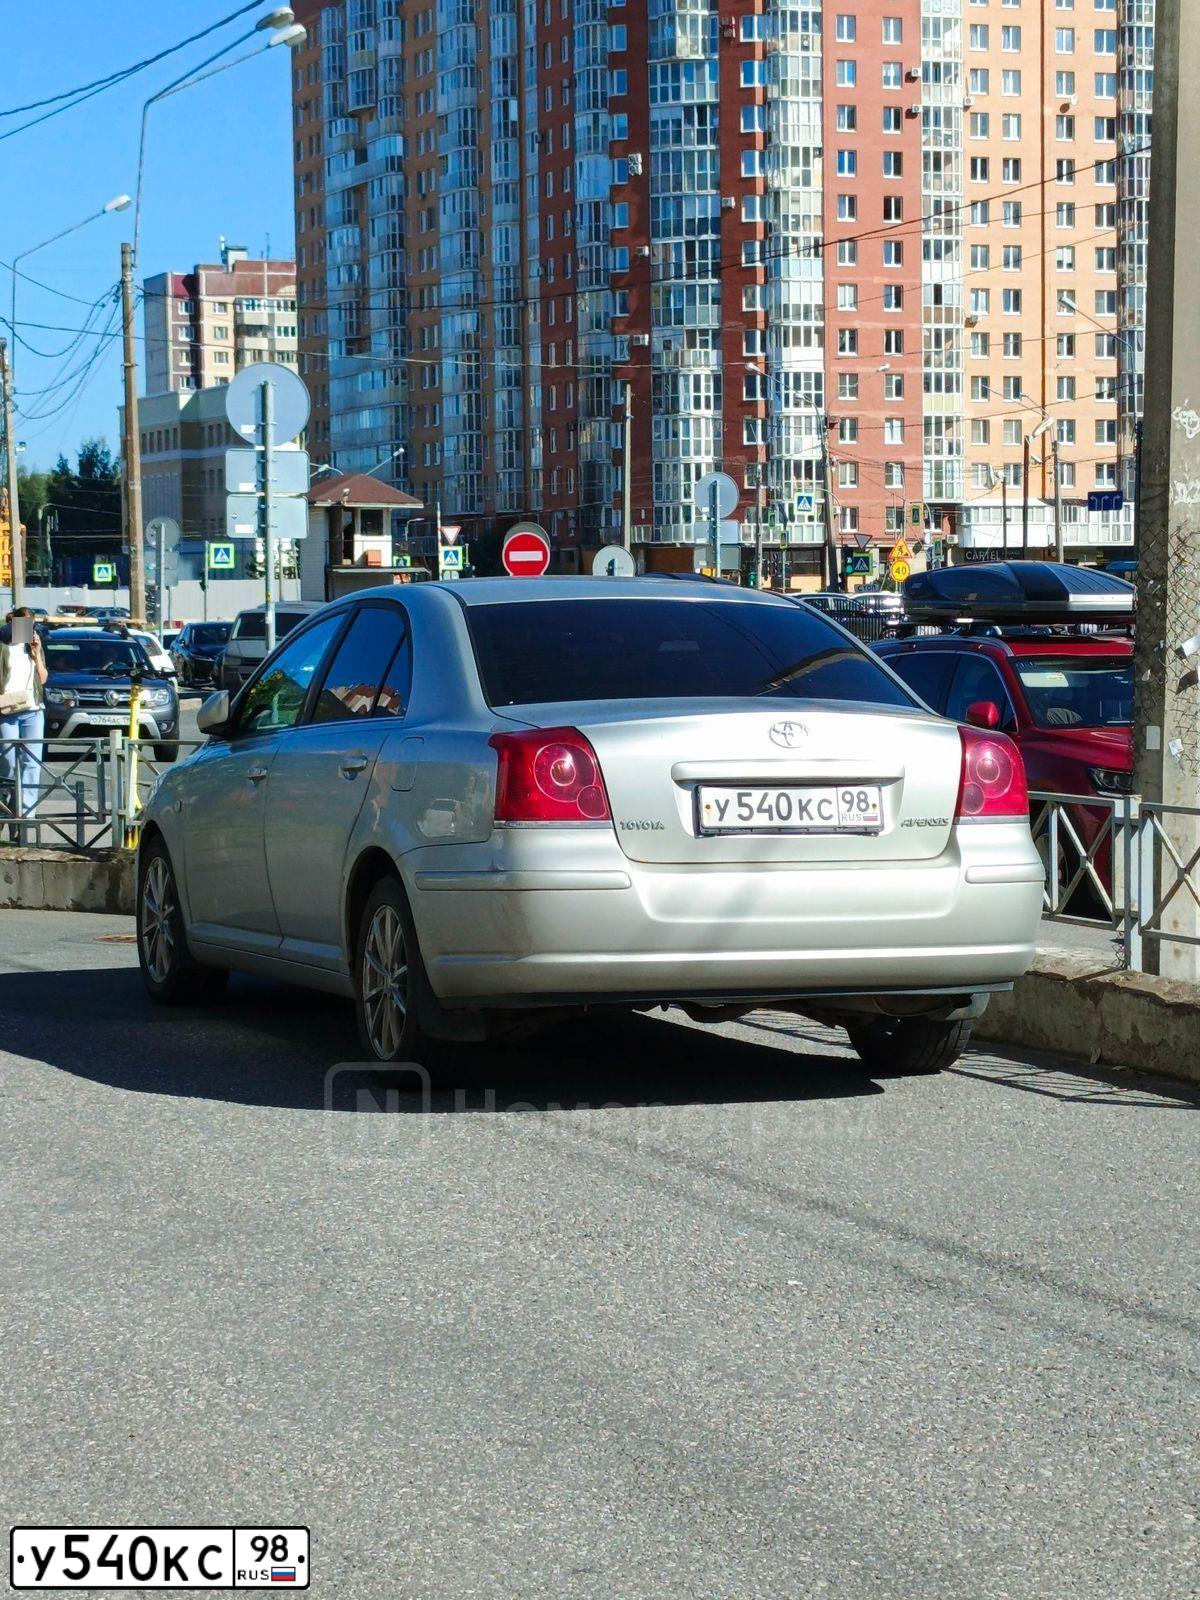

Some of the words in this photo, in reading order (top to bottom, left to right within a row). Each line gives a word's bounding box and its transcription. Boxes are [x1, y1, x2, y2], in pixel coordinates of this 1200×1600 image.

[895, 566, 908, 576] 40
[841, 790, 871, 814] 98
[841, 812, 863, 823] RUS
[901, 816, 949, 828] AVENSIS
[619, 819, 665, 830] TOYOTA
